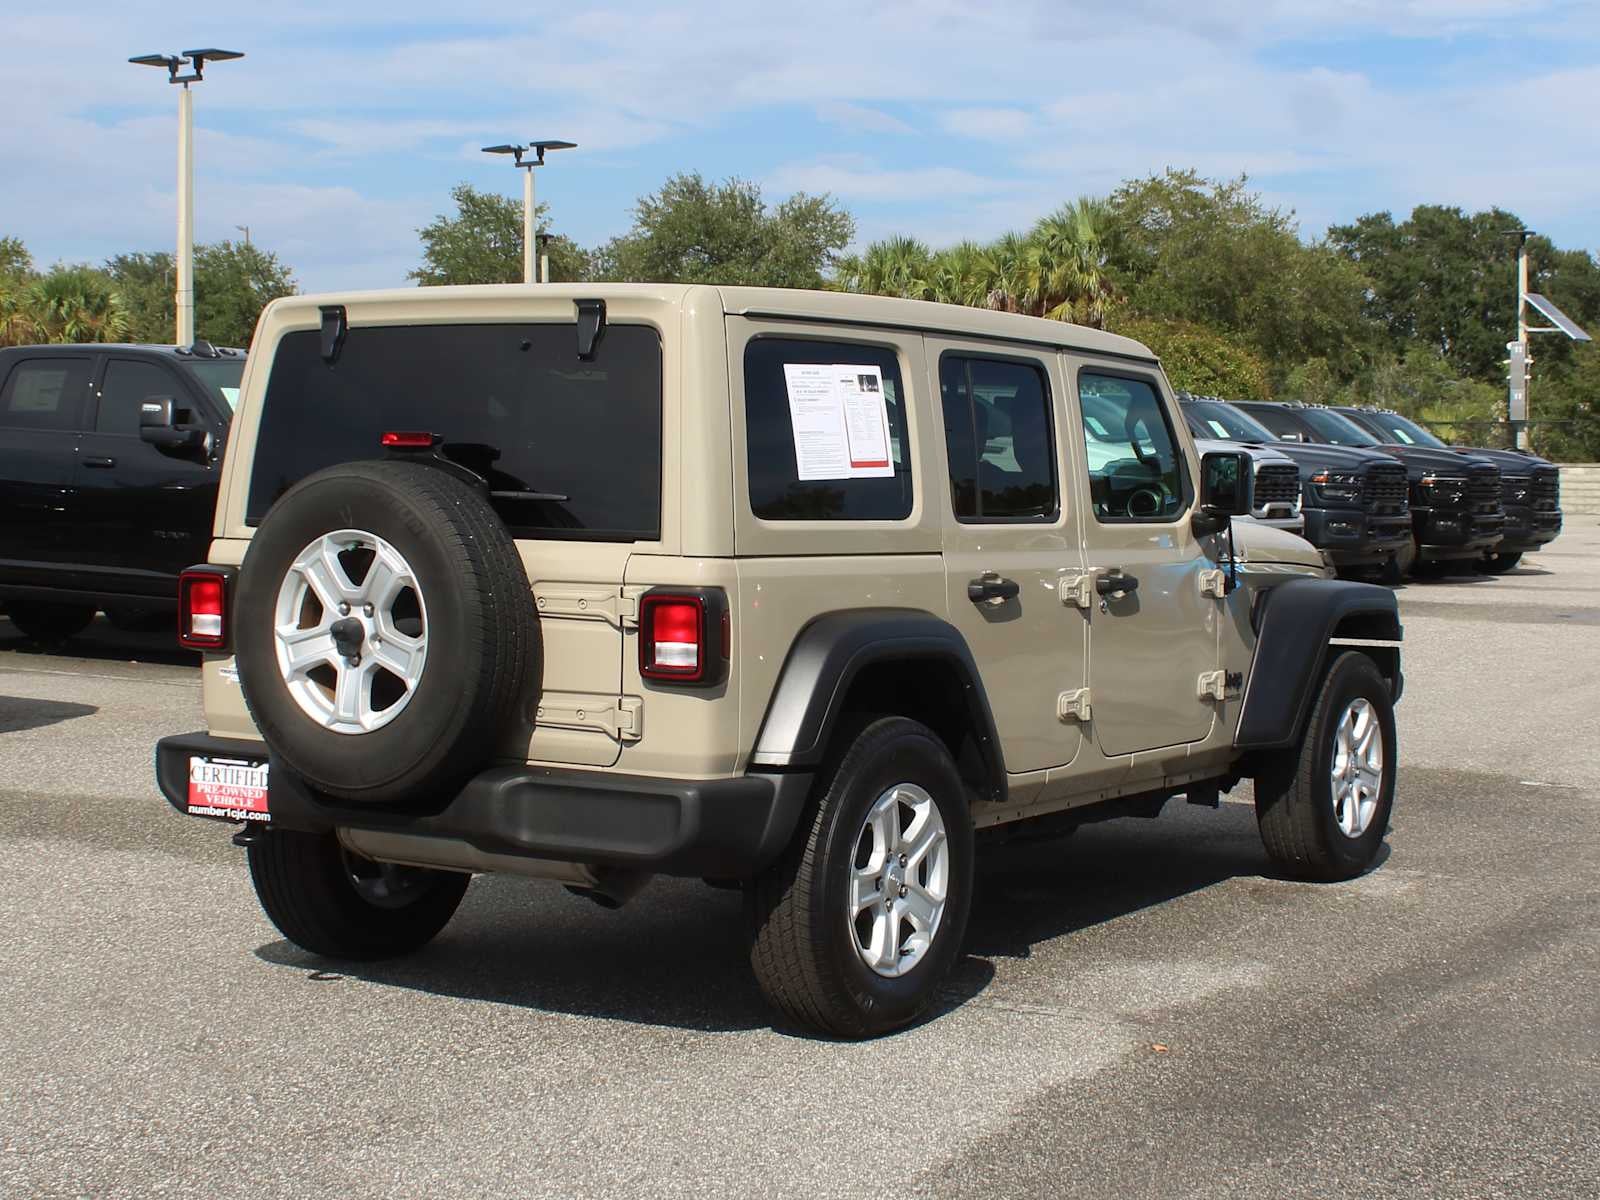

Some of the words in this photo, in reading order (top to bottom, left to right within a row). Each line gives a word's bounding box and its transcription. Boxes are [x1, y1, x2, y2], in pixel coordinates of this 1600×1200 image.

[191, 765, 268, 787] CERTIFIED
[196, 784, 264, 799] PRE-OWNED
[205, 794, 255, 808] VEHICLE
[188, 805, 271, 821] number1cjd.com
